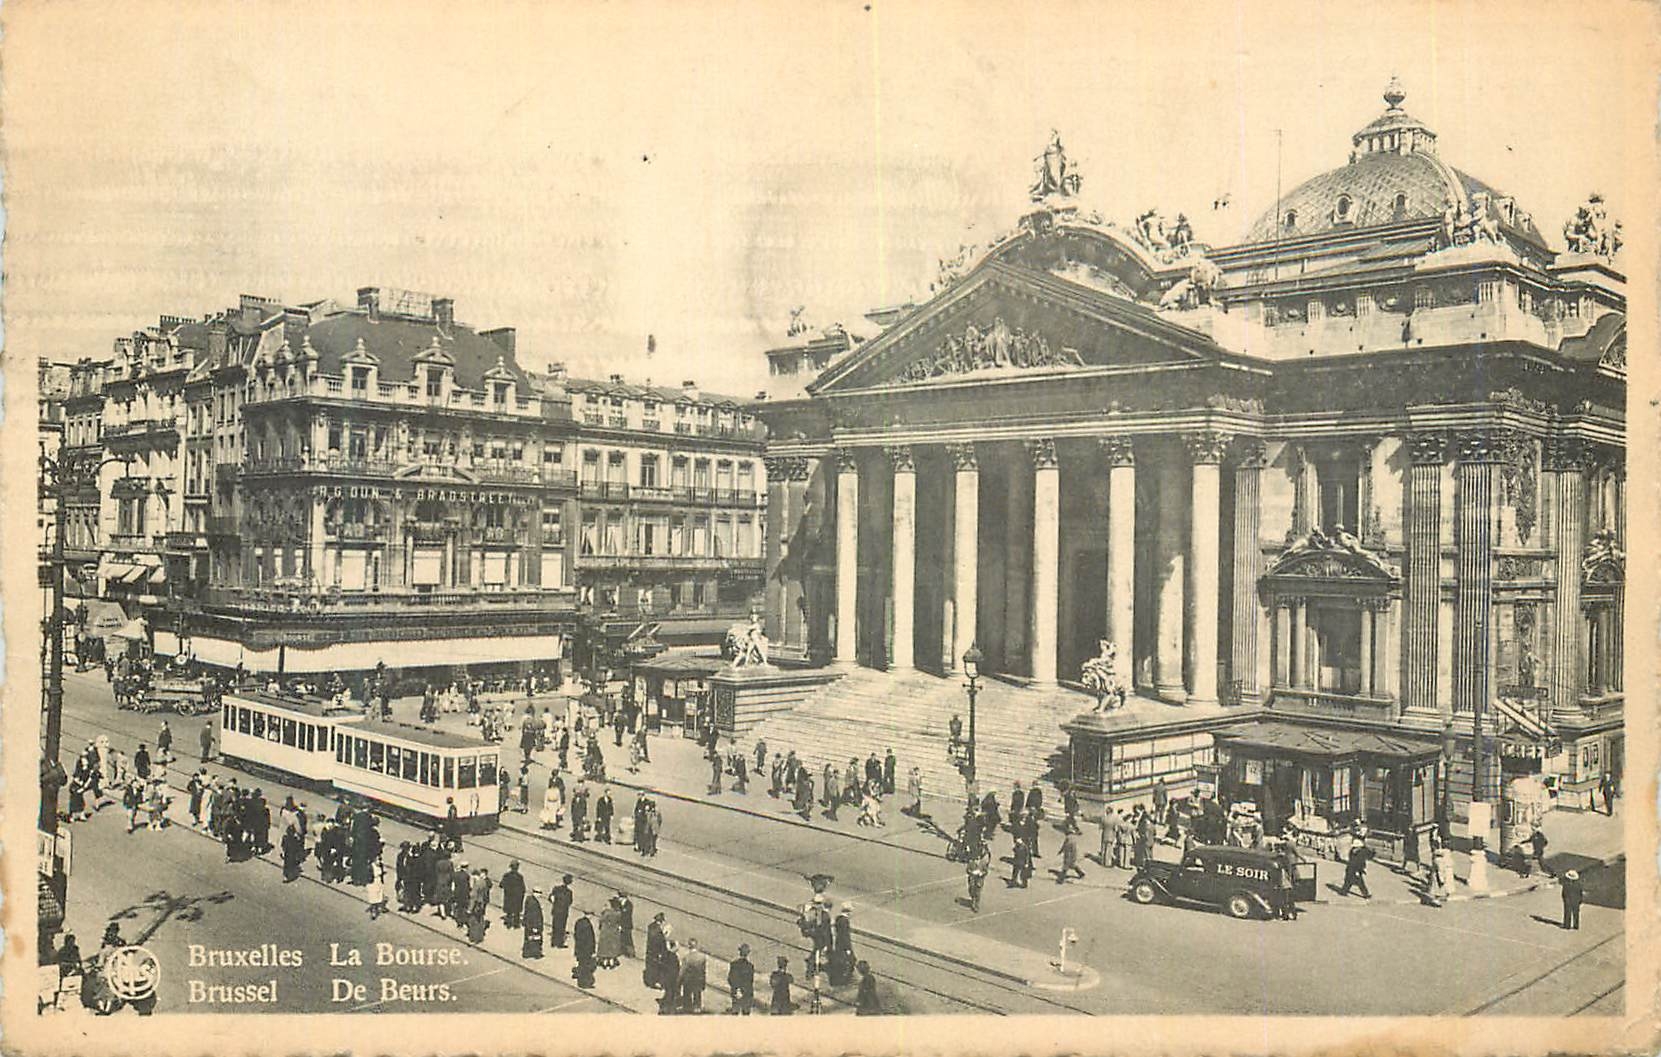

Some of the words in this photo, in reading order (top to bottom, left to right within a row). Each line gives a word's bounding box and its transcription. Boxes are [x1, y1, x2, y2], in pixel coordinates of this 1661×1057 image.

[417, 488, 514, 505] BRADSTREET
[1217, 864, 1233, 875] LE
[1236, 867, 1269, 880] SOIR
